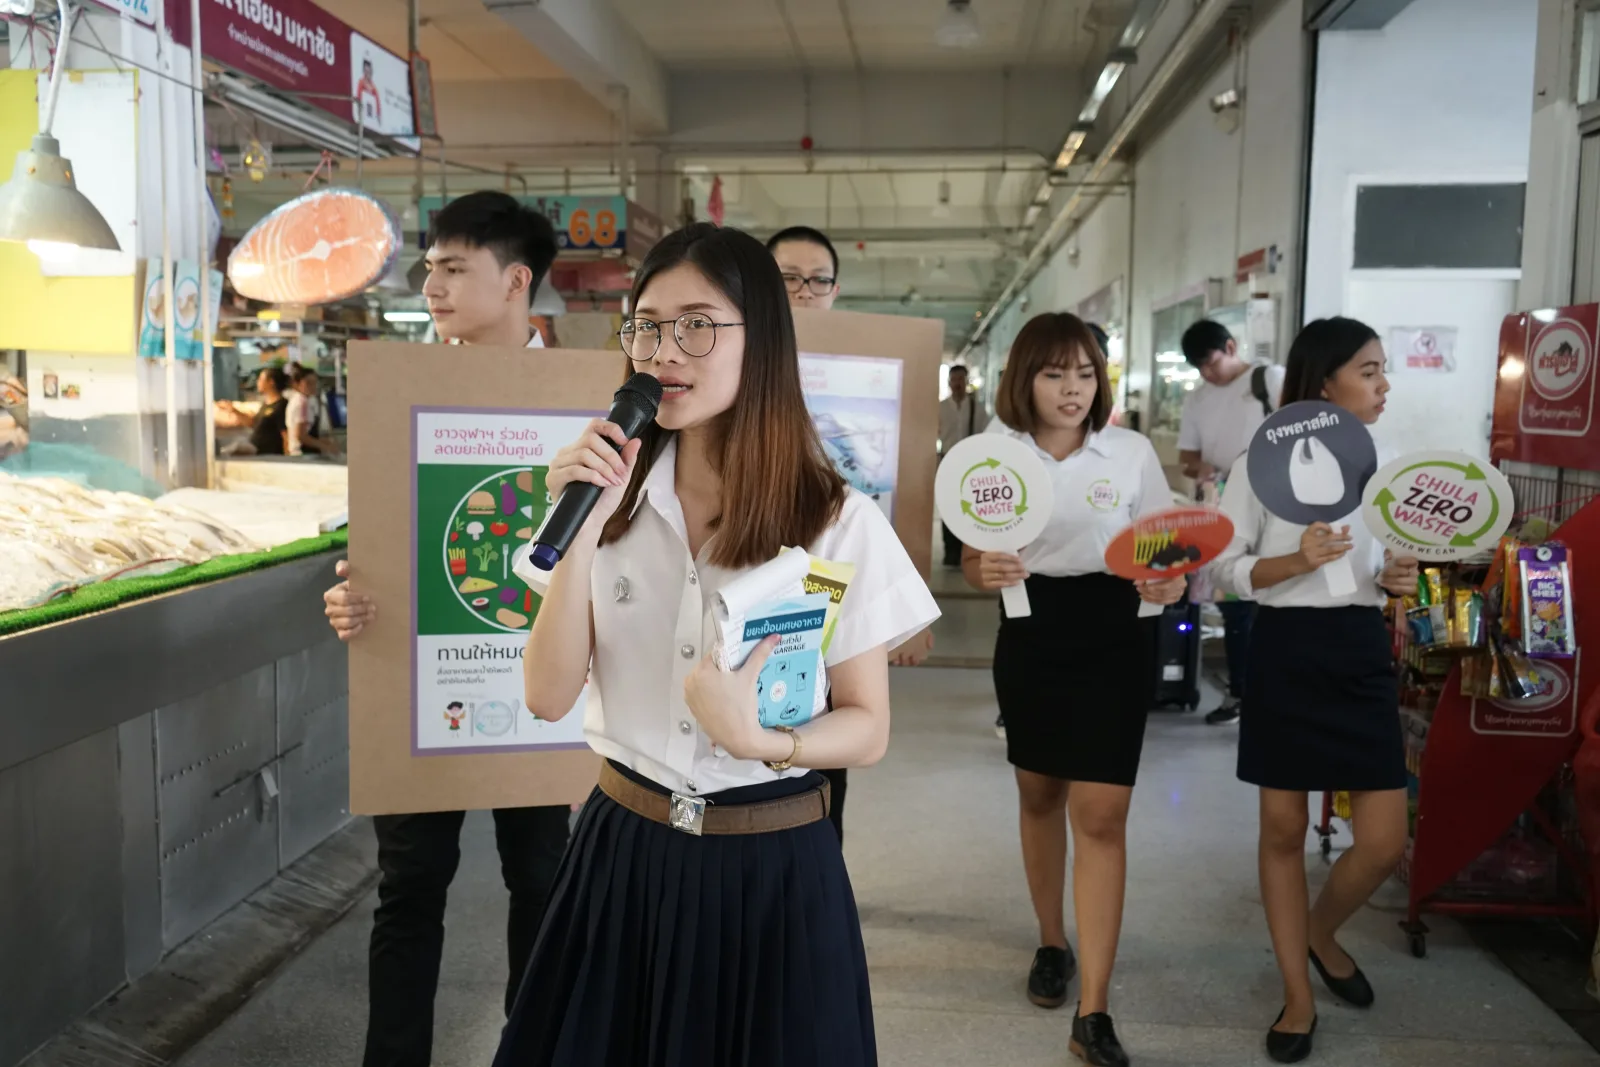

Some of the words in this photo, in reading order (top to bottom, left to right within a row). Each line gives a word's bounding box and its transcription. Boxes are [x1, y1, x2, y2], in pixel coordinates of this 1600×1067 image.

[284, 16, 335, 66] มหาชัย
[568, 208, 618, 247] 68
[434, 428, 494, 442] ชาวจุฬาฯ
[499, 426, 538, 441] ร่วมใจ
[1265, 411, 1340, 445] ถุงพลาสติก
[434, 441, 544, 460] ลดขยะให้เป็นศูนย์
[969, 474, 1009, 488] CHULA
[1414, 473, 1479, 506] CHULA
[972, 485, 1014, 504] ZERO
[975, 501, 1014, 516] WASTE
[1402, 487, 1473, 524] ZERO
[1394, 505, 1458, 538] WASTE
[1417, 547, 1431, 555] WE
[746, 616, 823, 637] ขยะเปื้อนเศษอาหาร
[773, 643, 807, 655] GARBAGE
